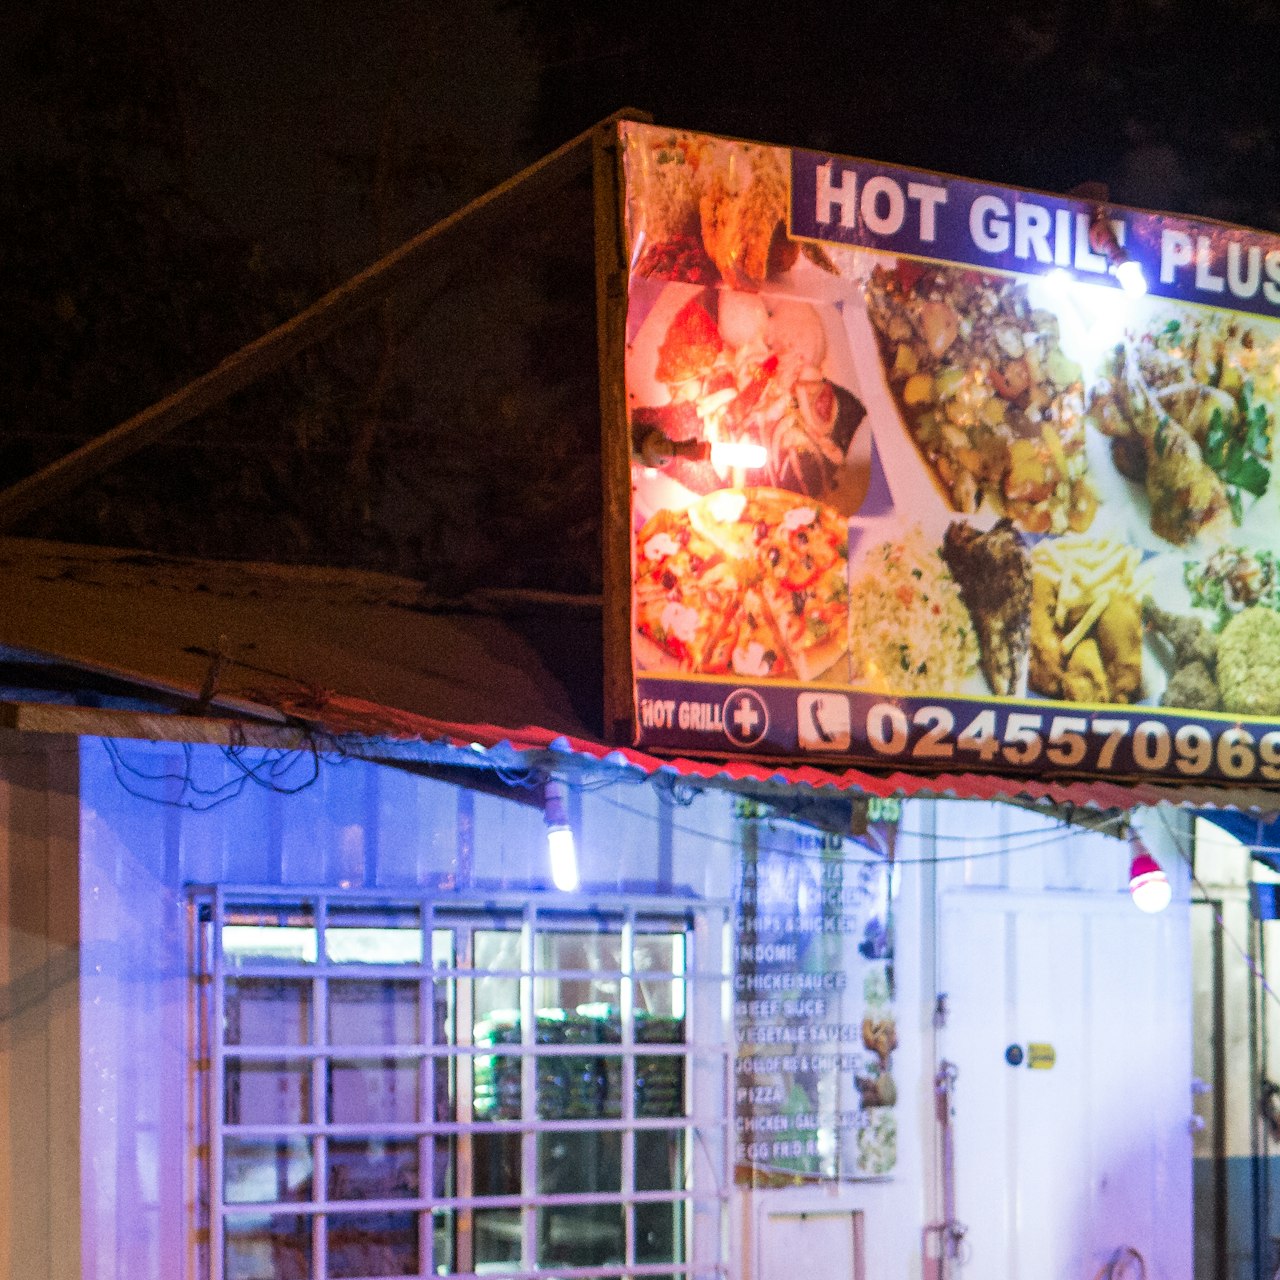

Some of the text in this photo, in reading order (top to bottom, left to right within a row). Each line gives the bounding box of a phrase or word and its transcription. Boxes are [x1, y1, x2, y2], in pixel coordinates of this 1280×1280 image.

[814, 161, 948, 243] HOT
[641, 699, 723, 732] HOT GRILL
